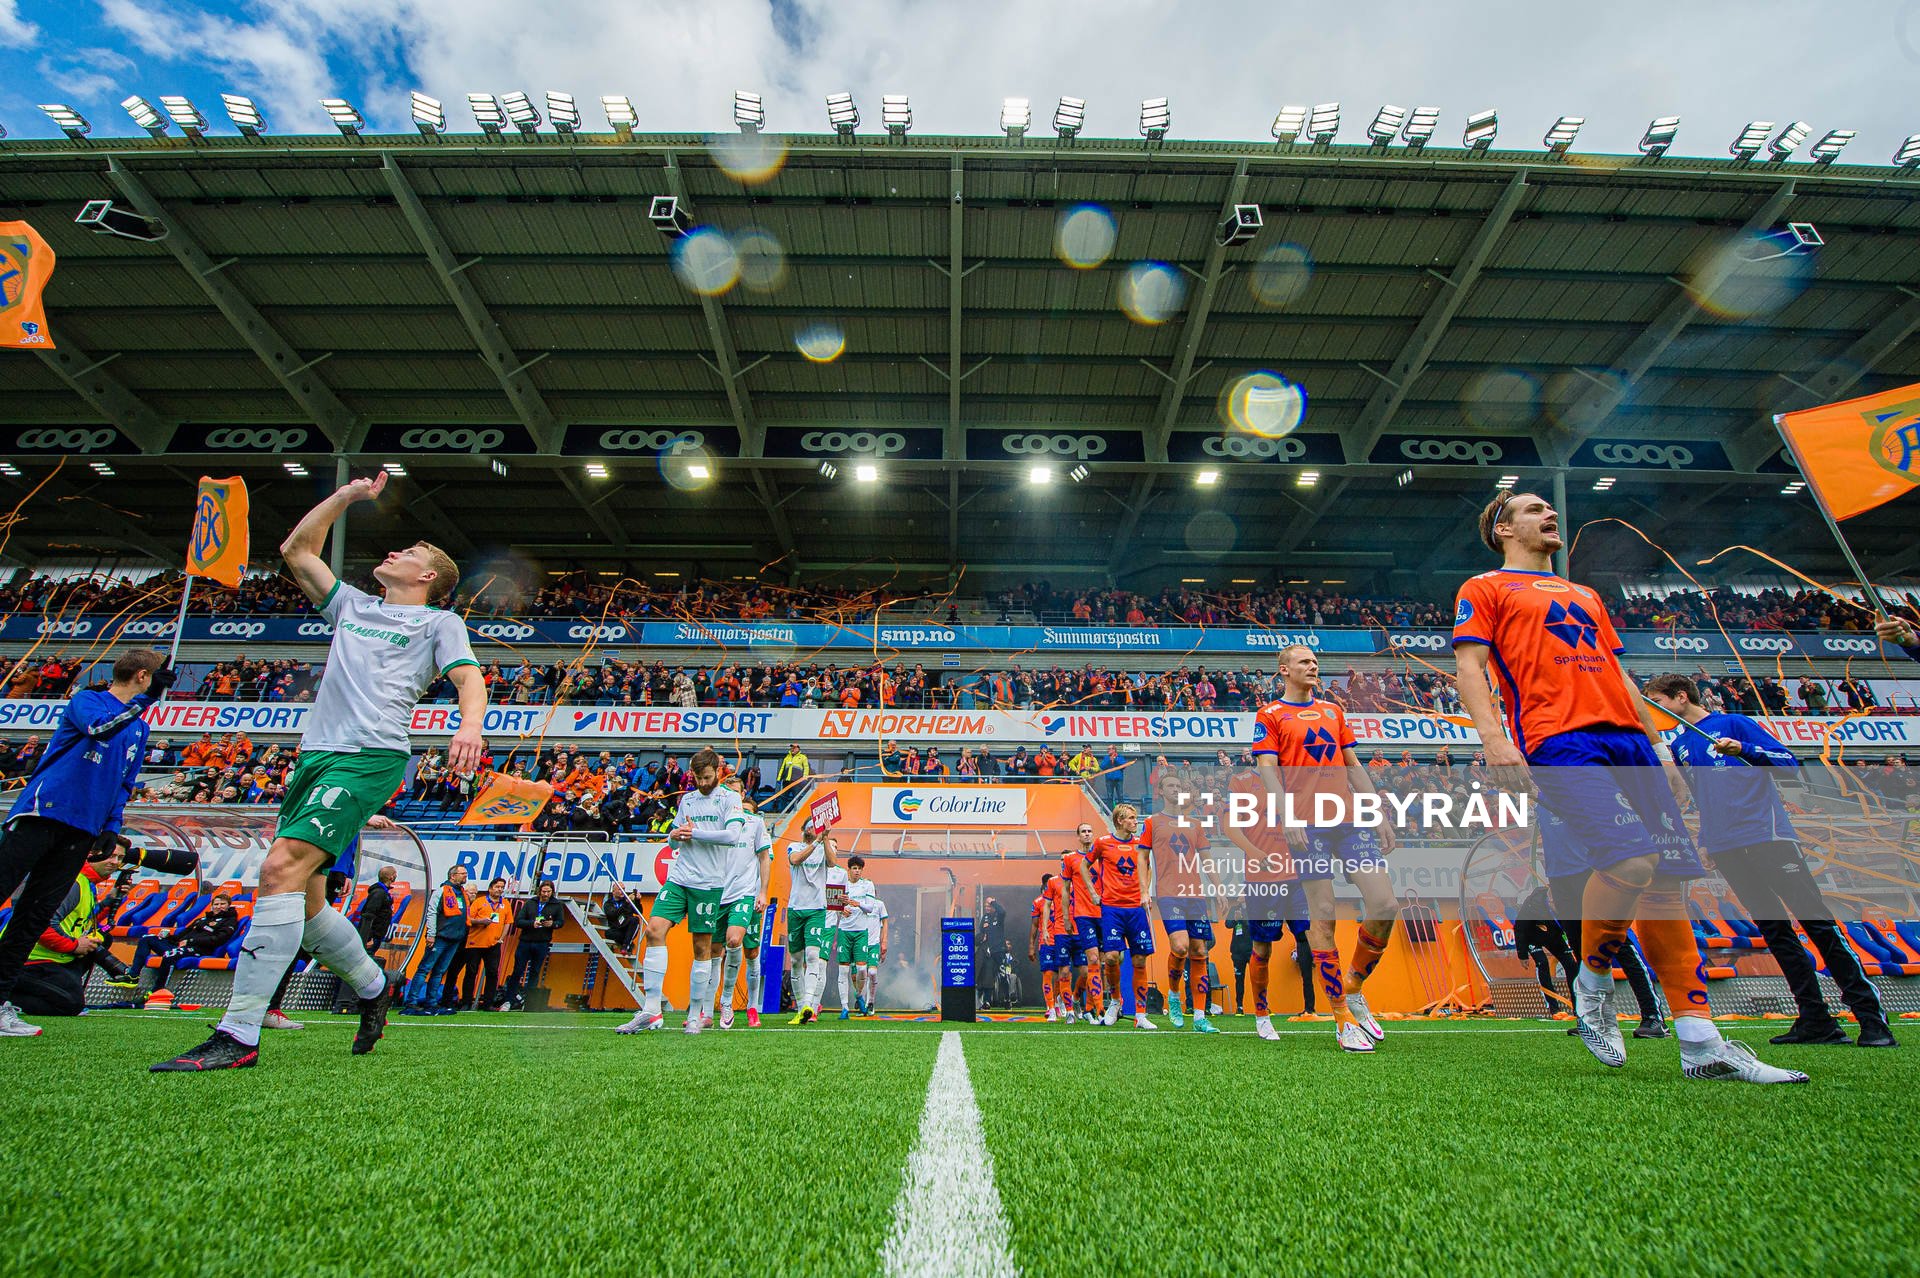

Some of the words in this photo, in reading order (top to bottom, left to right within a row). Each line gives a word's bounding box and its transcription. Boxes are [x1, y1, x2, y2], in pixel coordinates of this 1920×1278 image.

[17, 429, 117, 453] coop
[205, 428, 308, 453] coop
[400, 429, 505, 453] coop
[600, 430, 704, 455] coop
[801, 432, 906, 457] coop
[1002, 434, 1107, 459] coop
[1202, 437, 1307, 462] coop
[1400, 439, 1504, 465] coop
[1593, 443, 1694, 469] coop
[210, 622, 266, 638] coop
[477, 624, 535, 639] coop
[569, 624, 626, 639] coop
[881, 629, 956, 644] smp.no
[1043, 628, 1161, 646] Sunnmørsposten
[1246, 633, 1320, 648] smp.no
[1390, 634, 1446, 649] coop
[1654, 636, 1709, 652] coop
[1739, 637, 1793, 652] coop
[1823, 638, 1876, 653] coop
[599, 711, 772, 734] INTERSPORT
[1070, 716, 1237, 738] INTERSPORT
[327, 829, 336, 837] 6
[1663, 849, 1681, 860] 22
[455, 850, 643, 882] RINGDAL
